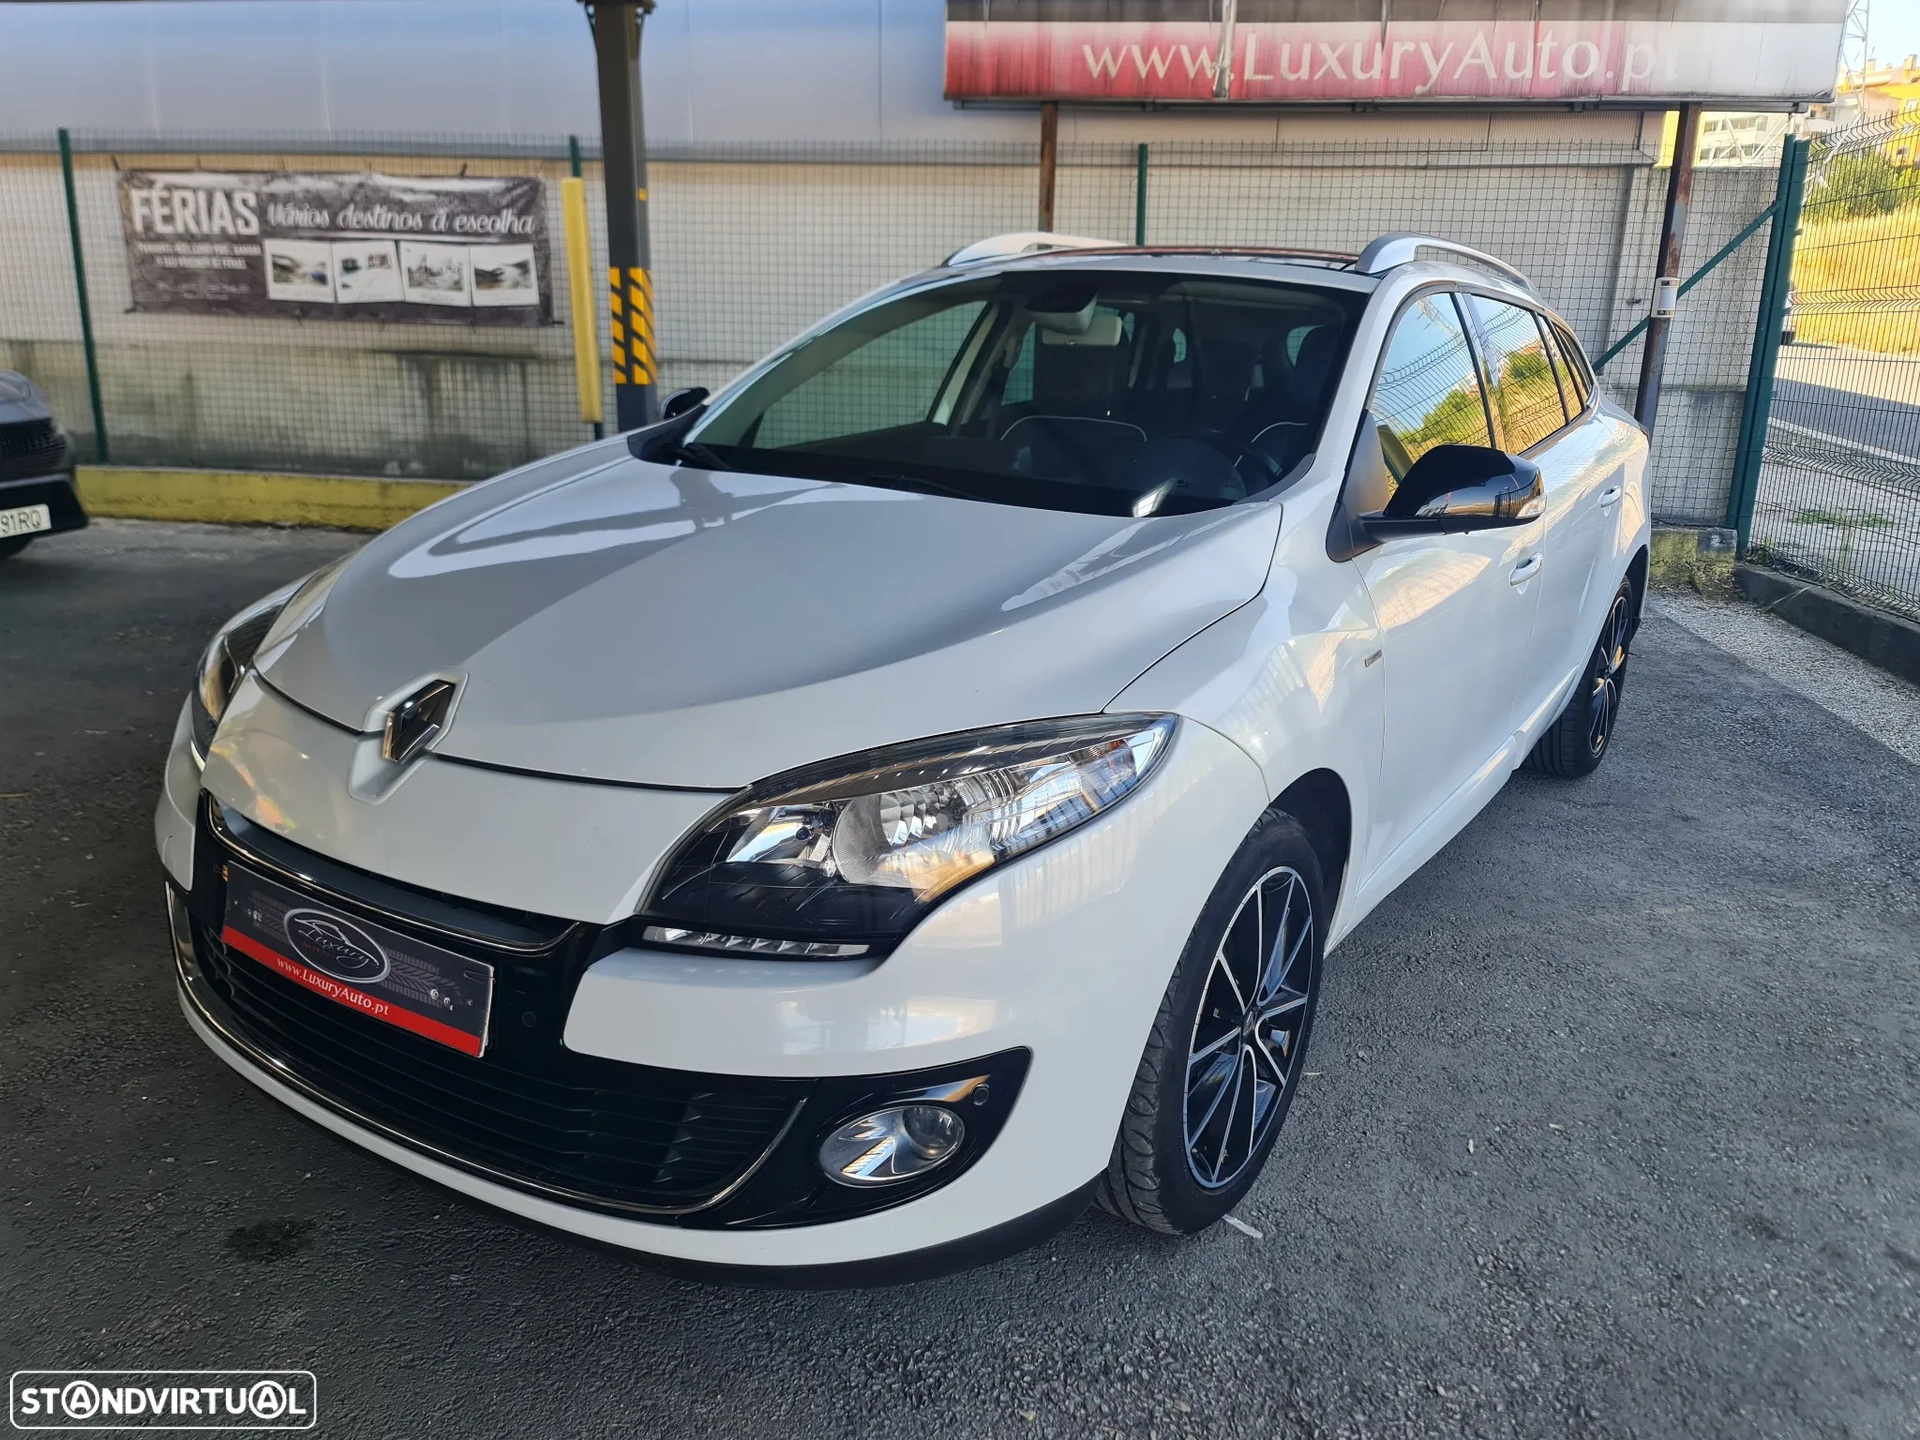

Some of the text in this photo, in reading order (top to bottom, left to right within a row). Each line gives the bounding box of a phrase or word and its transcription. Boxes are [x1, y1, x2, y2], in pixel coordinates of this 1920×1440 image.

[131, 181, 260, 235] FÉRIAS
[267, 200, 330, 227] Vários
[336, 203, 423, 231] destinos
[453, 208, 536, 234] escolha
[277, 958, 390, 1015] www.LuxuryAuto.pt
